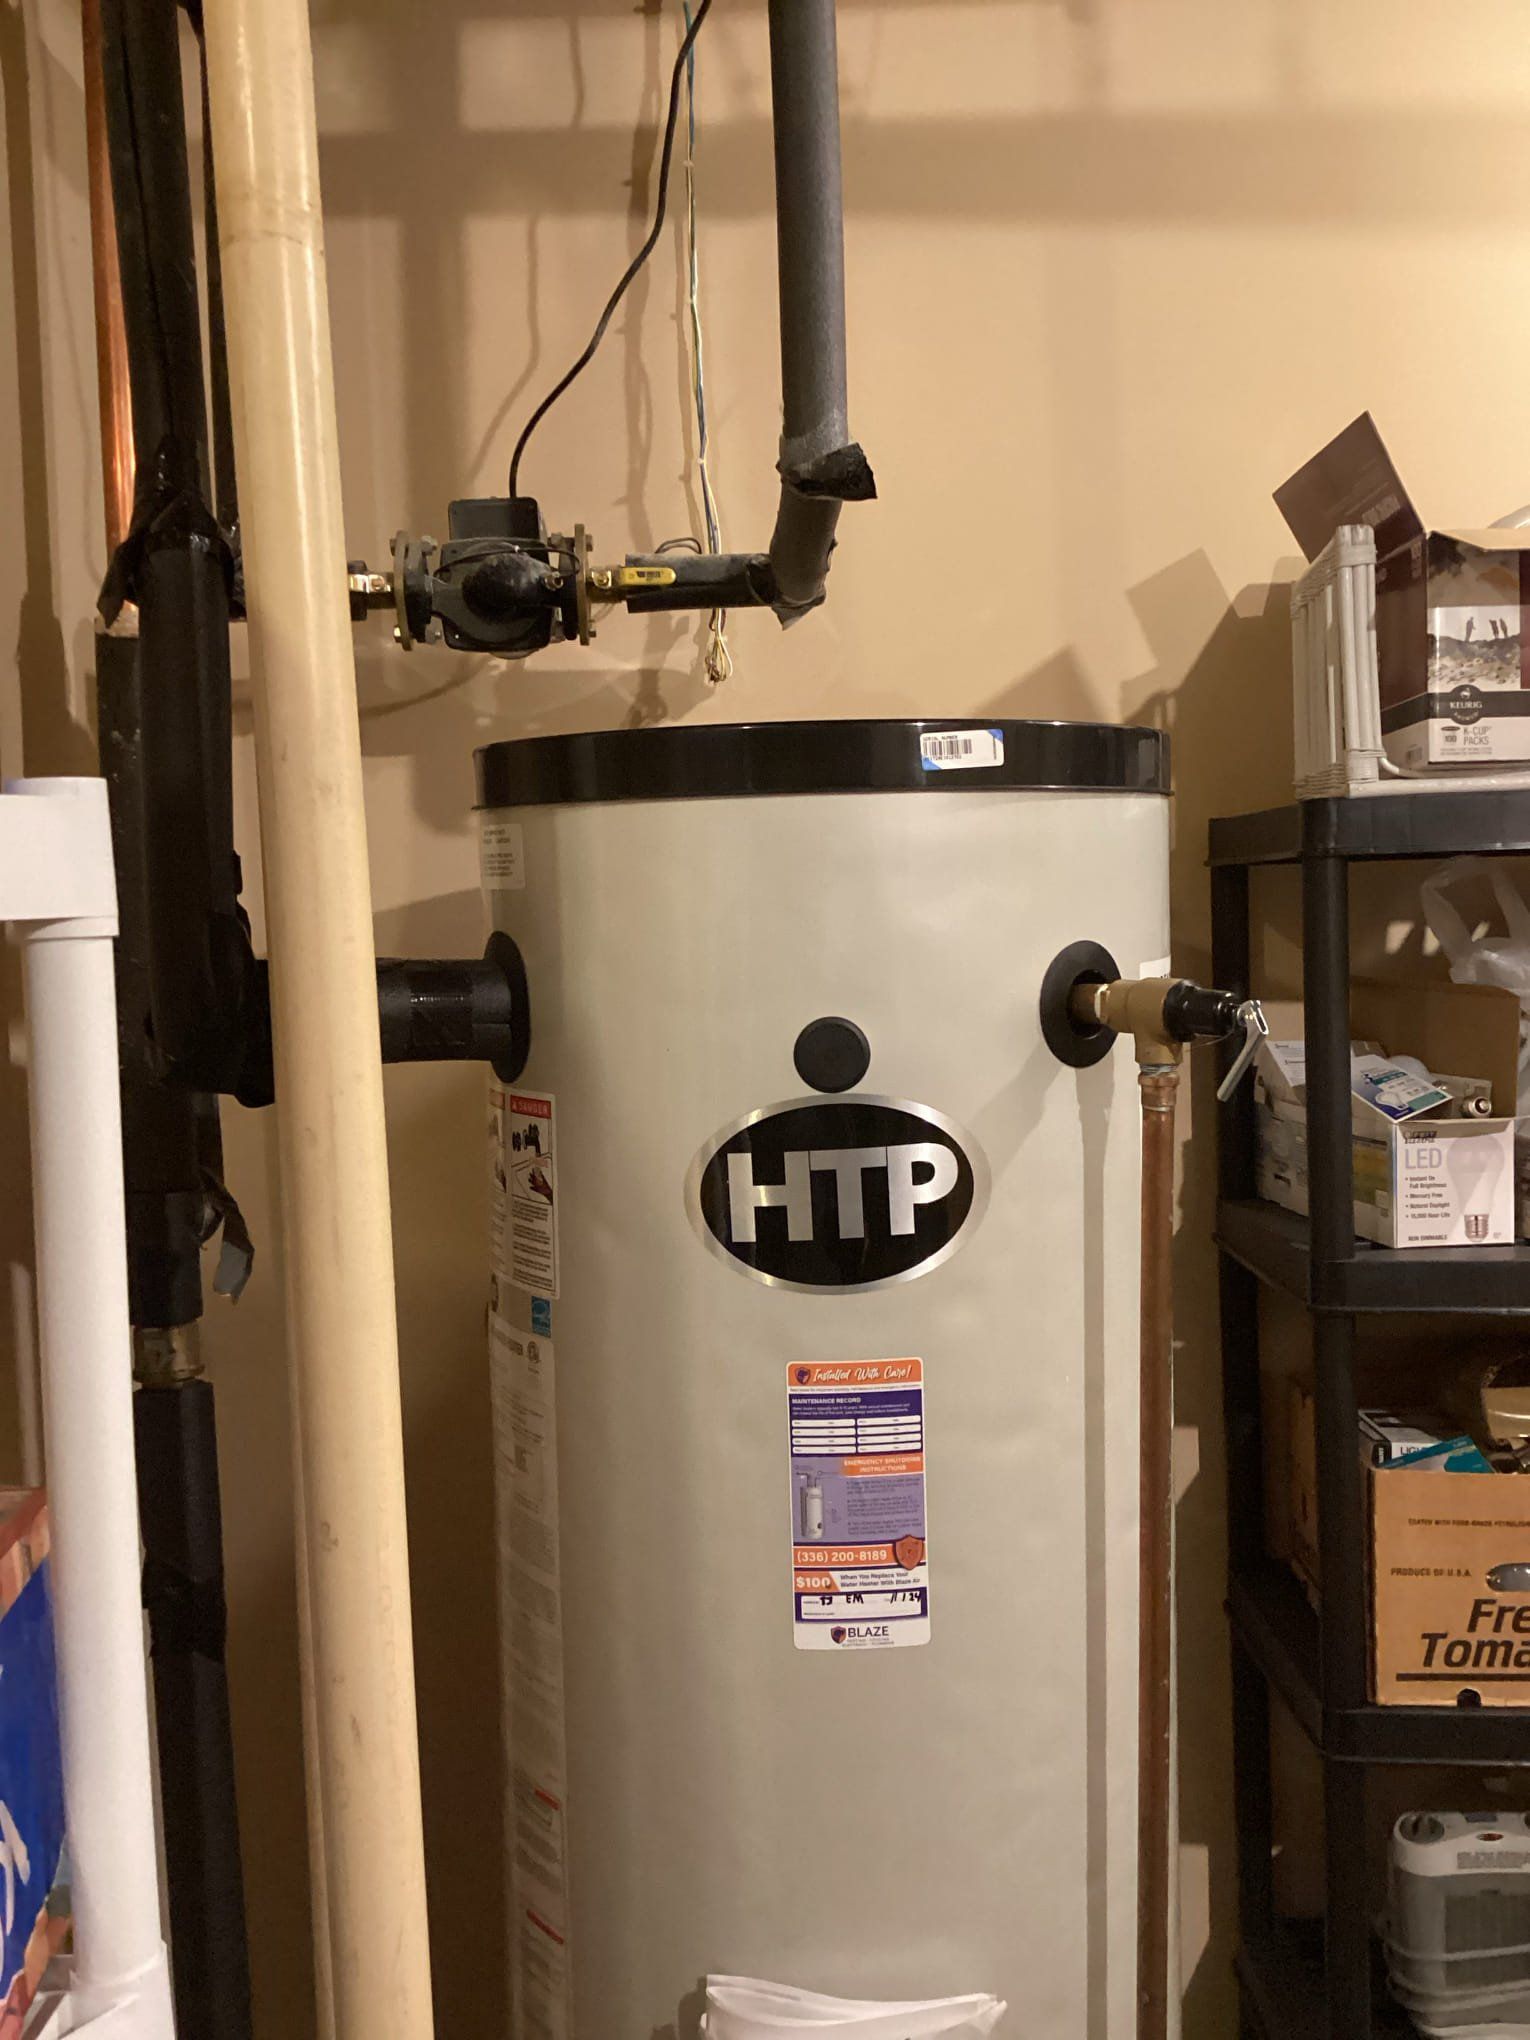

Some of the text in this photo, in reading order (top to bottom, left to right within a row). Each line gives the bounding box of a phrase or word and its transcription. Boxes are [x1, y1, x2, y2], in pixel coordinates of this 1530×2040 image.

[1450, 701, 1482, 709] KEURIG
[1464, 736, 1489, 745] PACKS
[1405, 1147, 1442, 1169] LED
[727, 1142, 958, 1242] HTP
[813, 1364, 912, 1382] Installed With Care!
[885, 1456, 921, 1464] SHUTDOWN
[860, 1465, 906, 1473] INSTRUCTIONS
[797, 1550, 887, 1563] (336) 200-8189
[1391, 1568, 1430, 1576] PRODUCE
[1434, 1568, 1444, 1576] OF
[796, 1576, 831, 1589] $100
[847, 1625, 889, 1638] BLAZE
